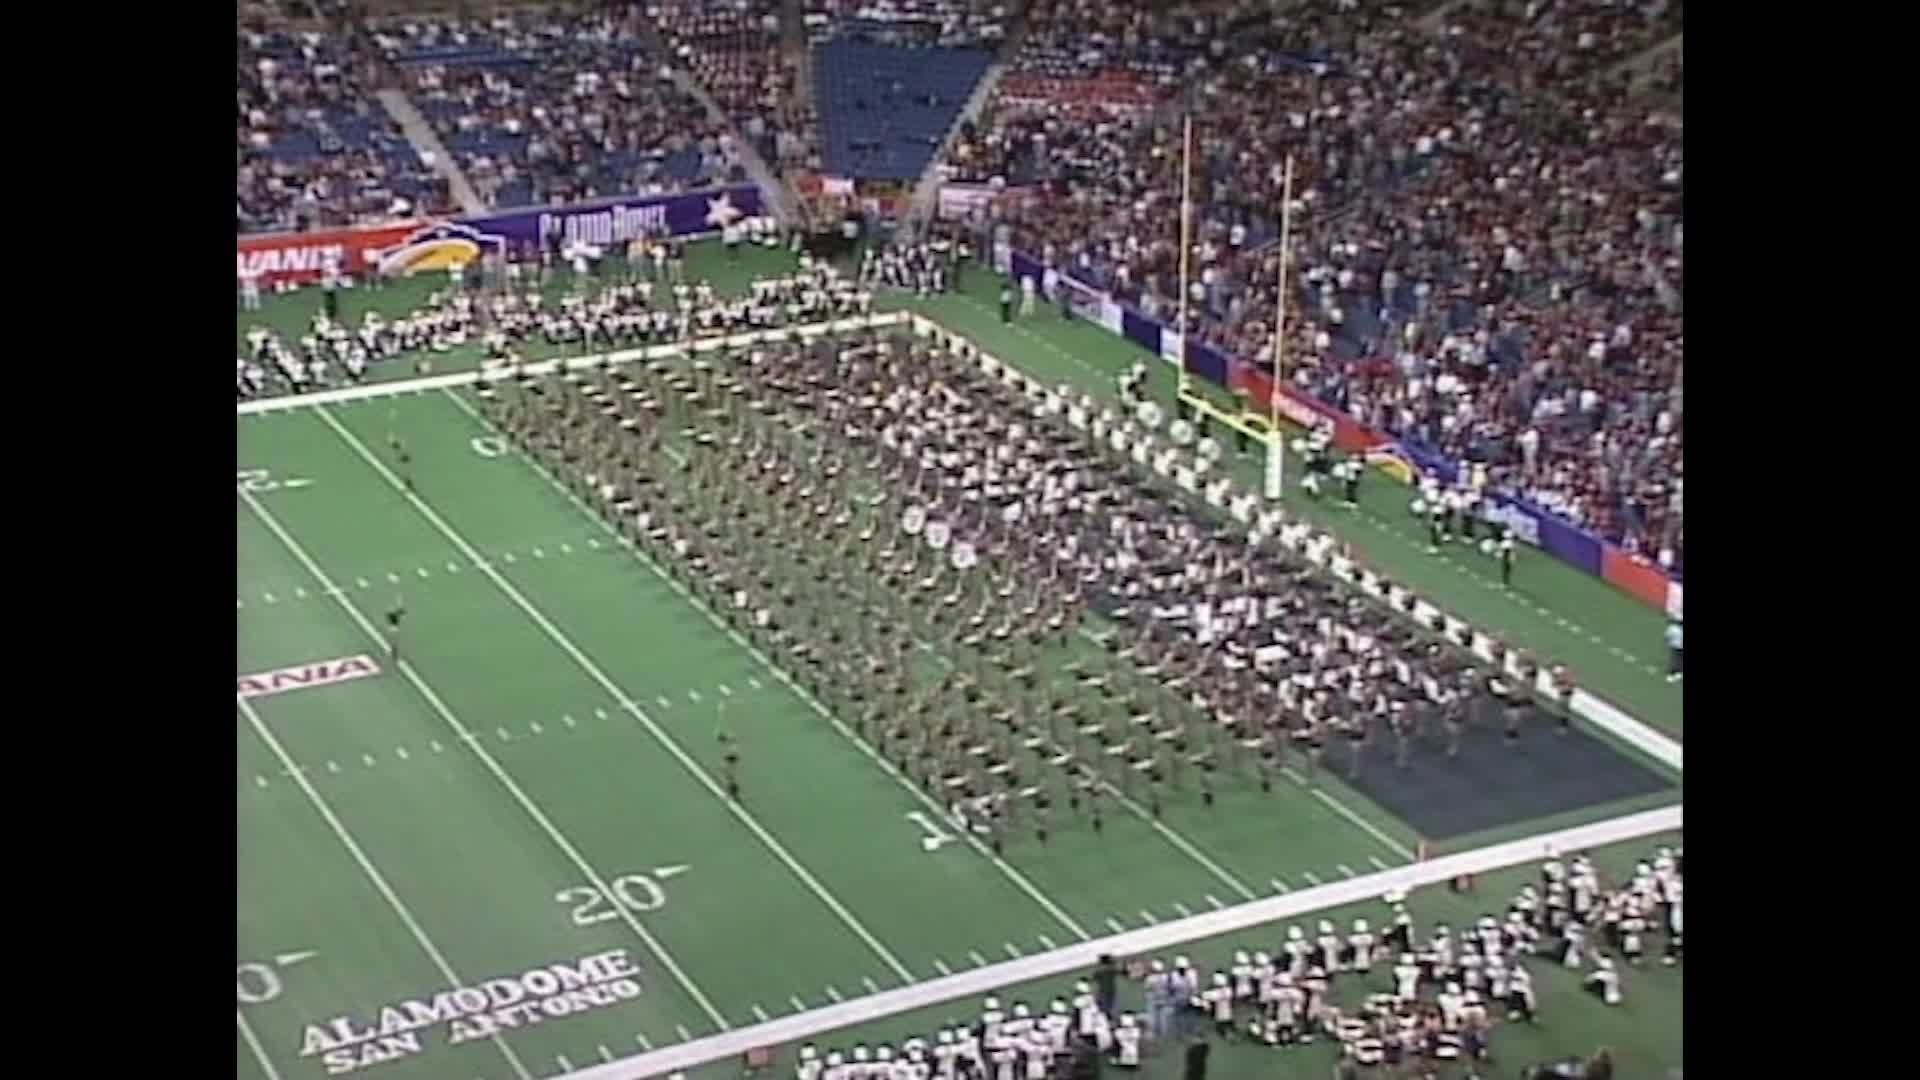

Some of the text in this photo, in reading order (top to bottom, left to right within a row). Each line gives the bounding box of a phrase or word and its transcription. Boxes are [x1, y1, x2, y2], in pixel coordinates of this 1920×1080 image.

[556, 875, 664, 925] 20
[301, 949, 640, 1057] ALAMODOME
[323, 979, 641, 1075] SAN ANTONIO
